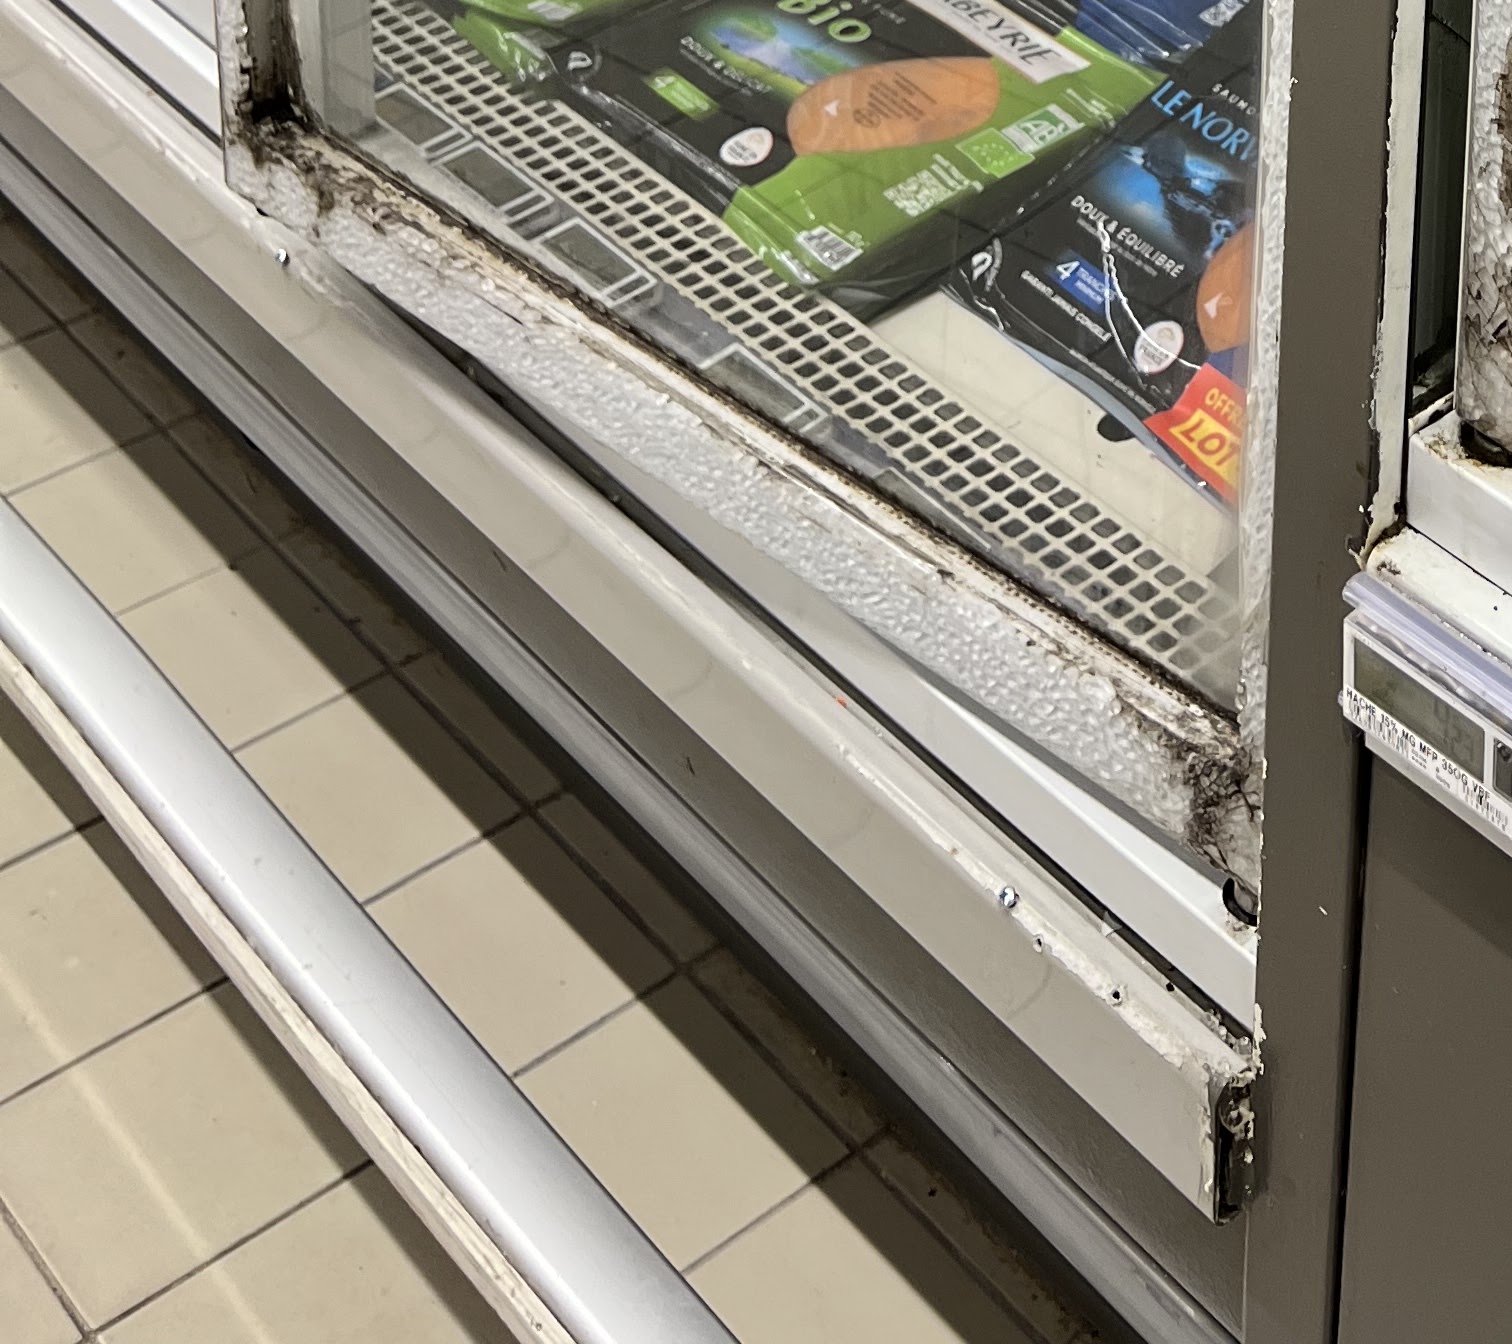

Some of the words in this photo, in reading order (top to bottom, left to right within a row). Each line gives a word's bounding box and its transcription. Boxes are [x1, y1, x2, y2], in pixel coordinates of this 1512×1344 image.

[1150, 80, 1193, 117] LE
[1211, 82, 1257, 116] SAUMO
[1055, 260, 1081, 282] 4
[1116, 226, 1186, 279] ÉQUILIBRÉ
[1346, 689, 1377, 717] HACHE
[1380, 713, 1399, 735] 15%
[1441, 757, 1469, 786] 350G
